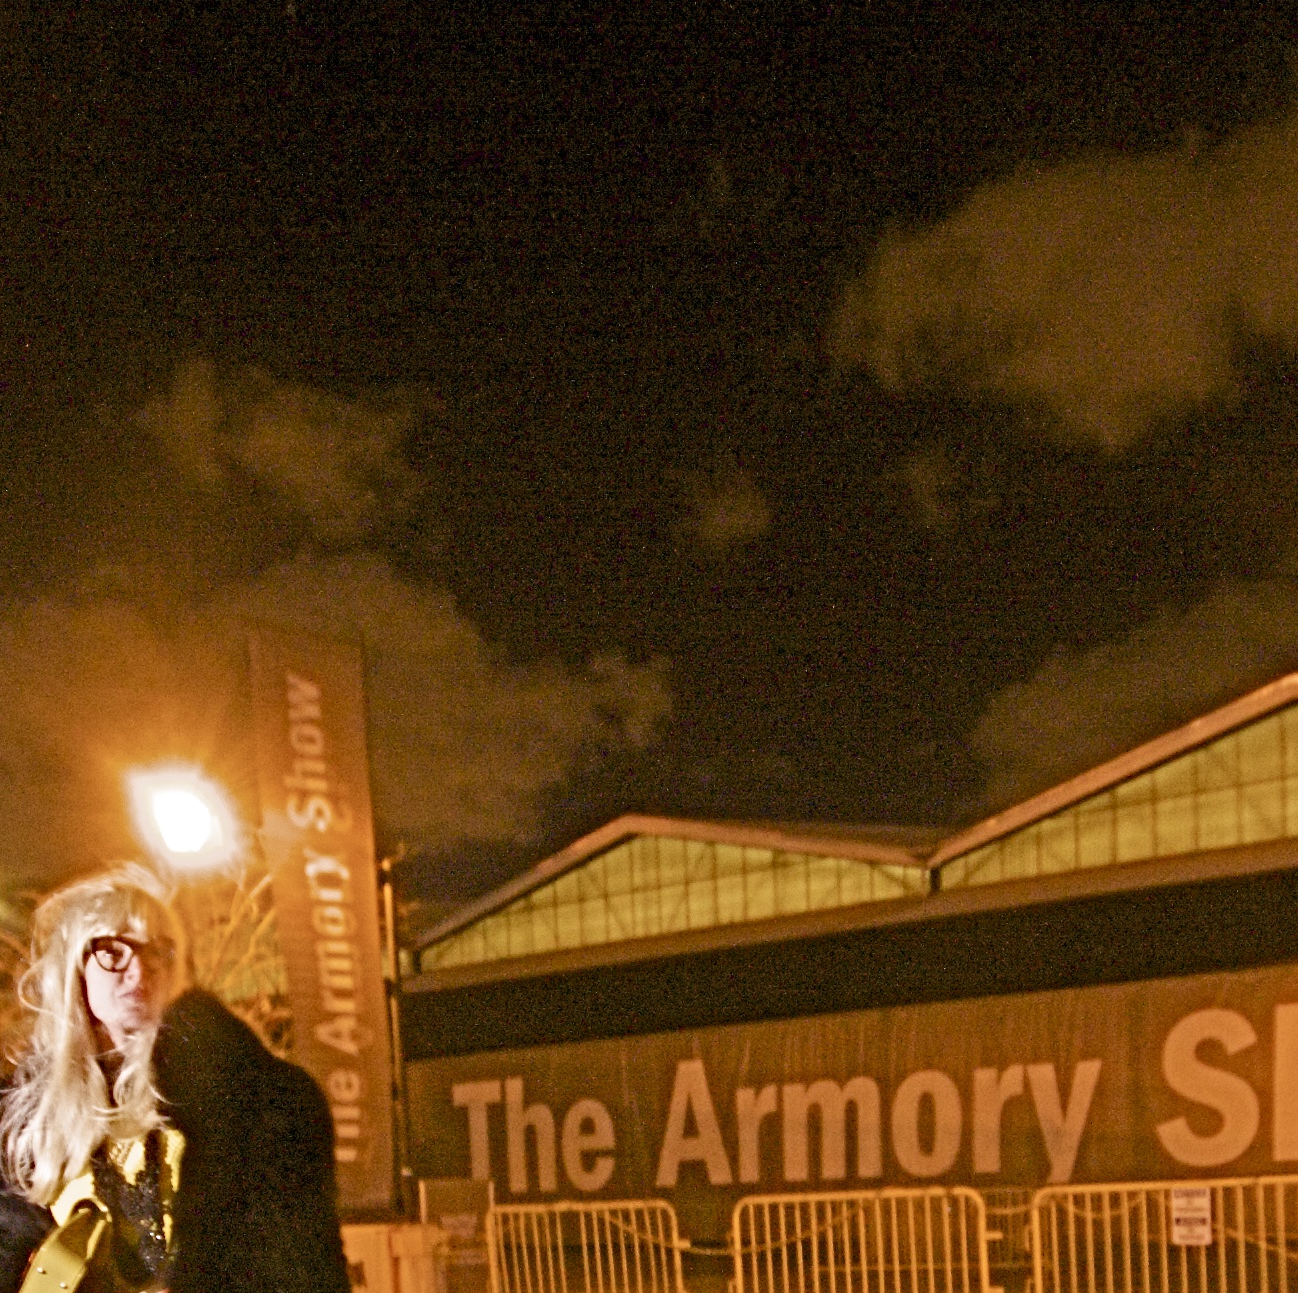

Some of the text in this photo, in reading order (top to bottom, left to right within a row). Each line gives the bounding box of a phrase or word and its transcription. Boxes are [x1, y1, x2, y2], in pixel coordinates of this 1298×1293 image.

[284, 672, 333, 833] Show
[304, 848, 360, 1058] Armory
[452, 1076, 616, 1193] The
[655, 1058, 1103, 1187] Armory
